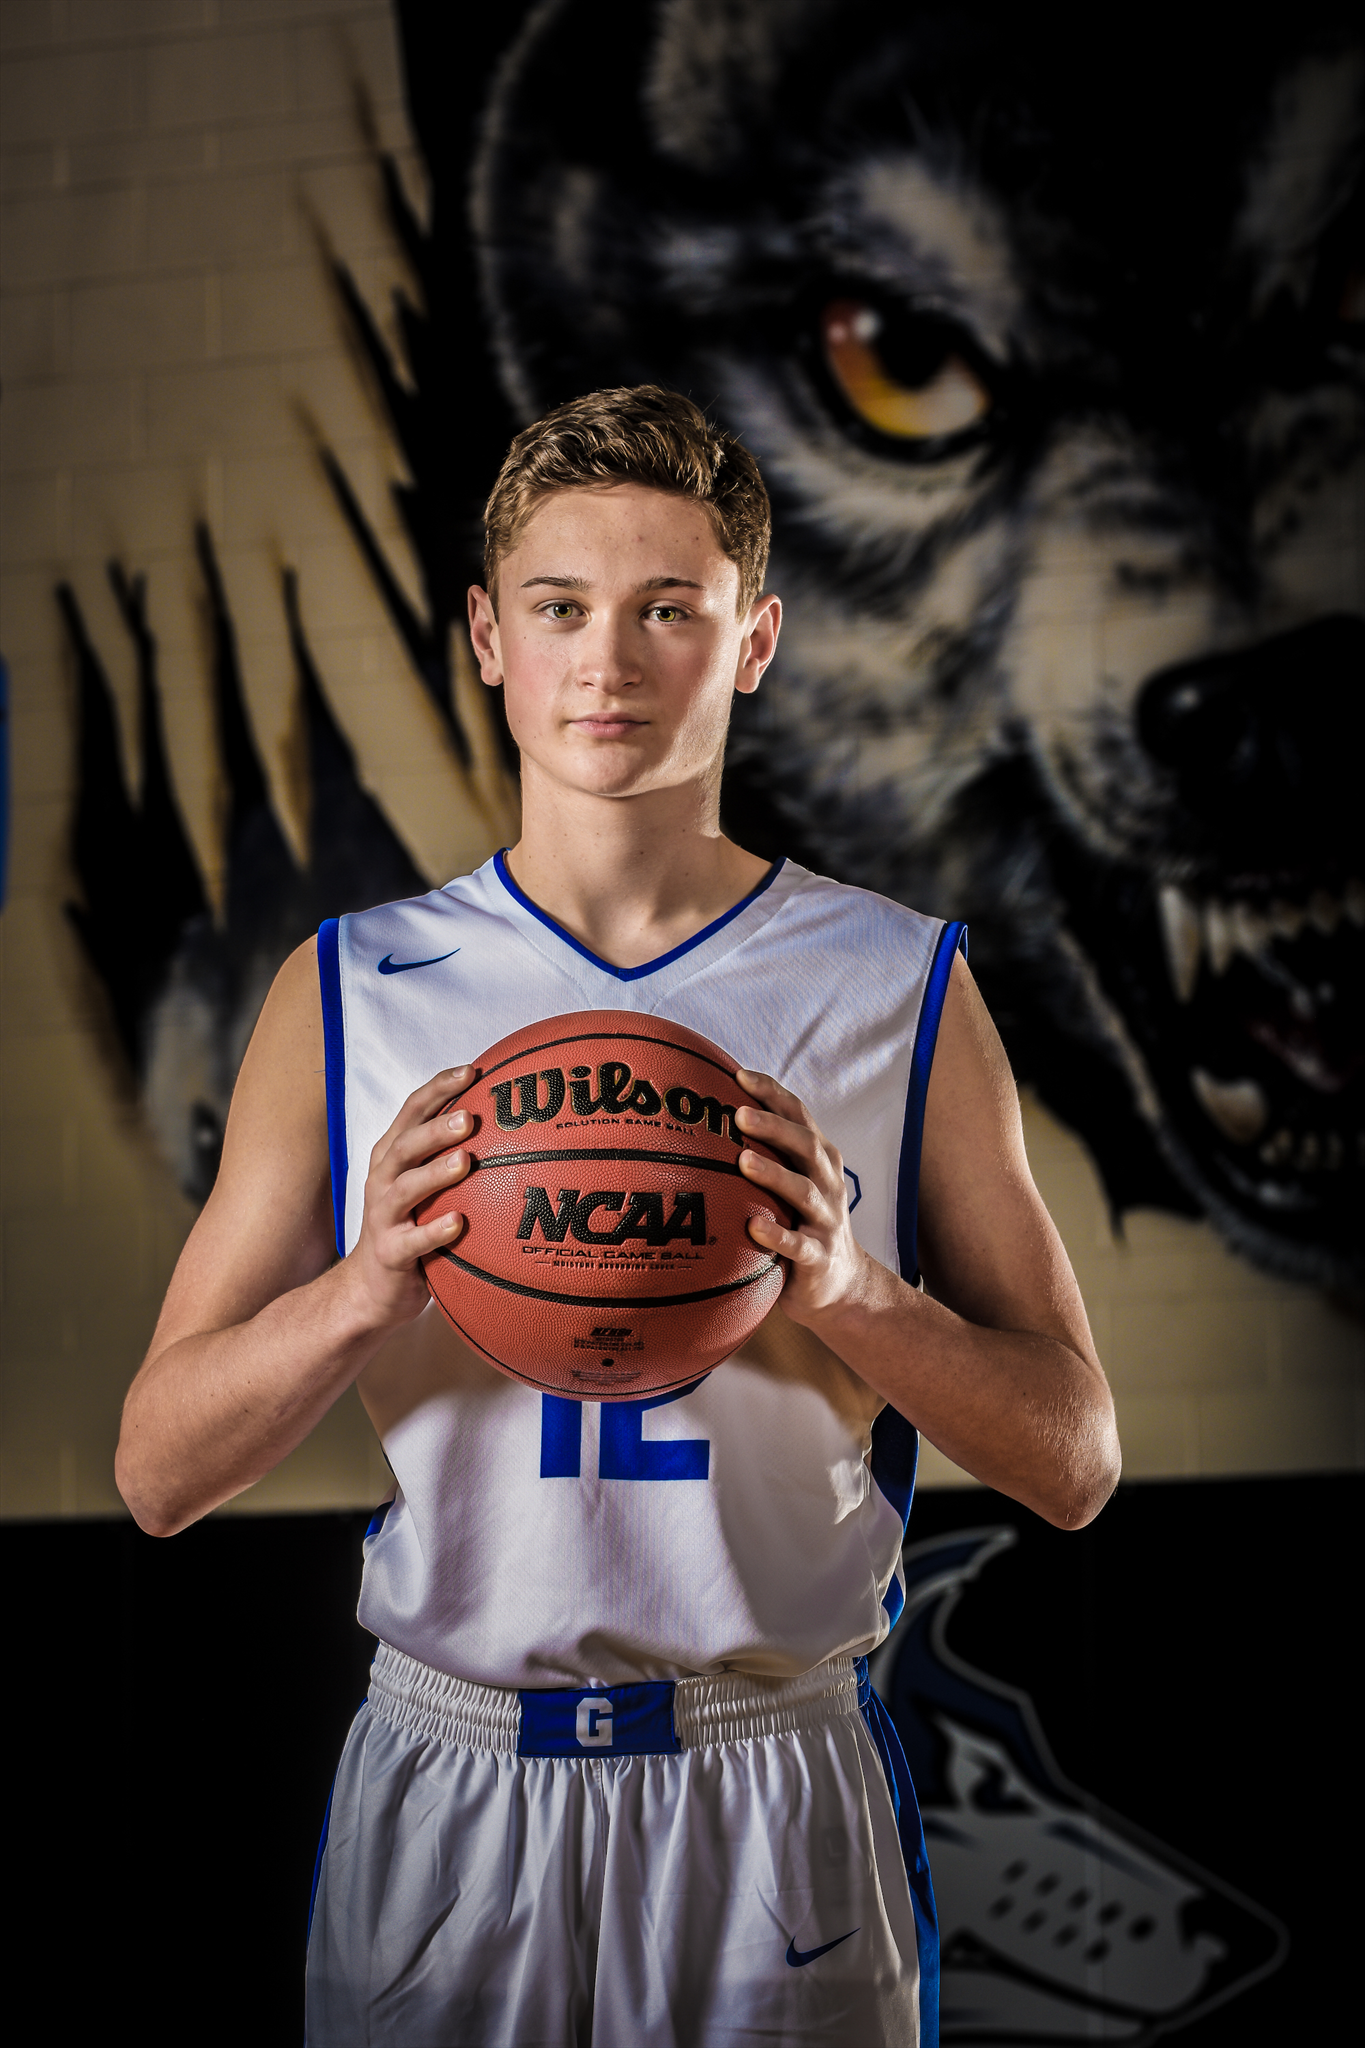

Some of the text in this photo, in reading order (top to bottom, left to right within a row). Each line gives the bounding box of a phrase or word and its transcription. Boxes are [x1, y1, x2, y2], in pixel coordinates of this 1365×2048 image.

[491, 1061, 747, 1149] Wilson
[556, 1118, 621, 1130] SOLUTION
[625, 1118, 662, 1128] GAME
[516, 1186, 706, 1246] NCAA
[522, 1246, 705, 1261] OFFICIAL GAME BALL
[576, 1697, 613, 1747] G
